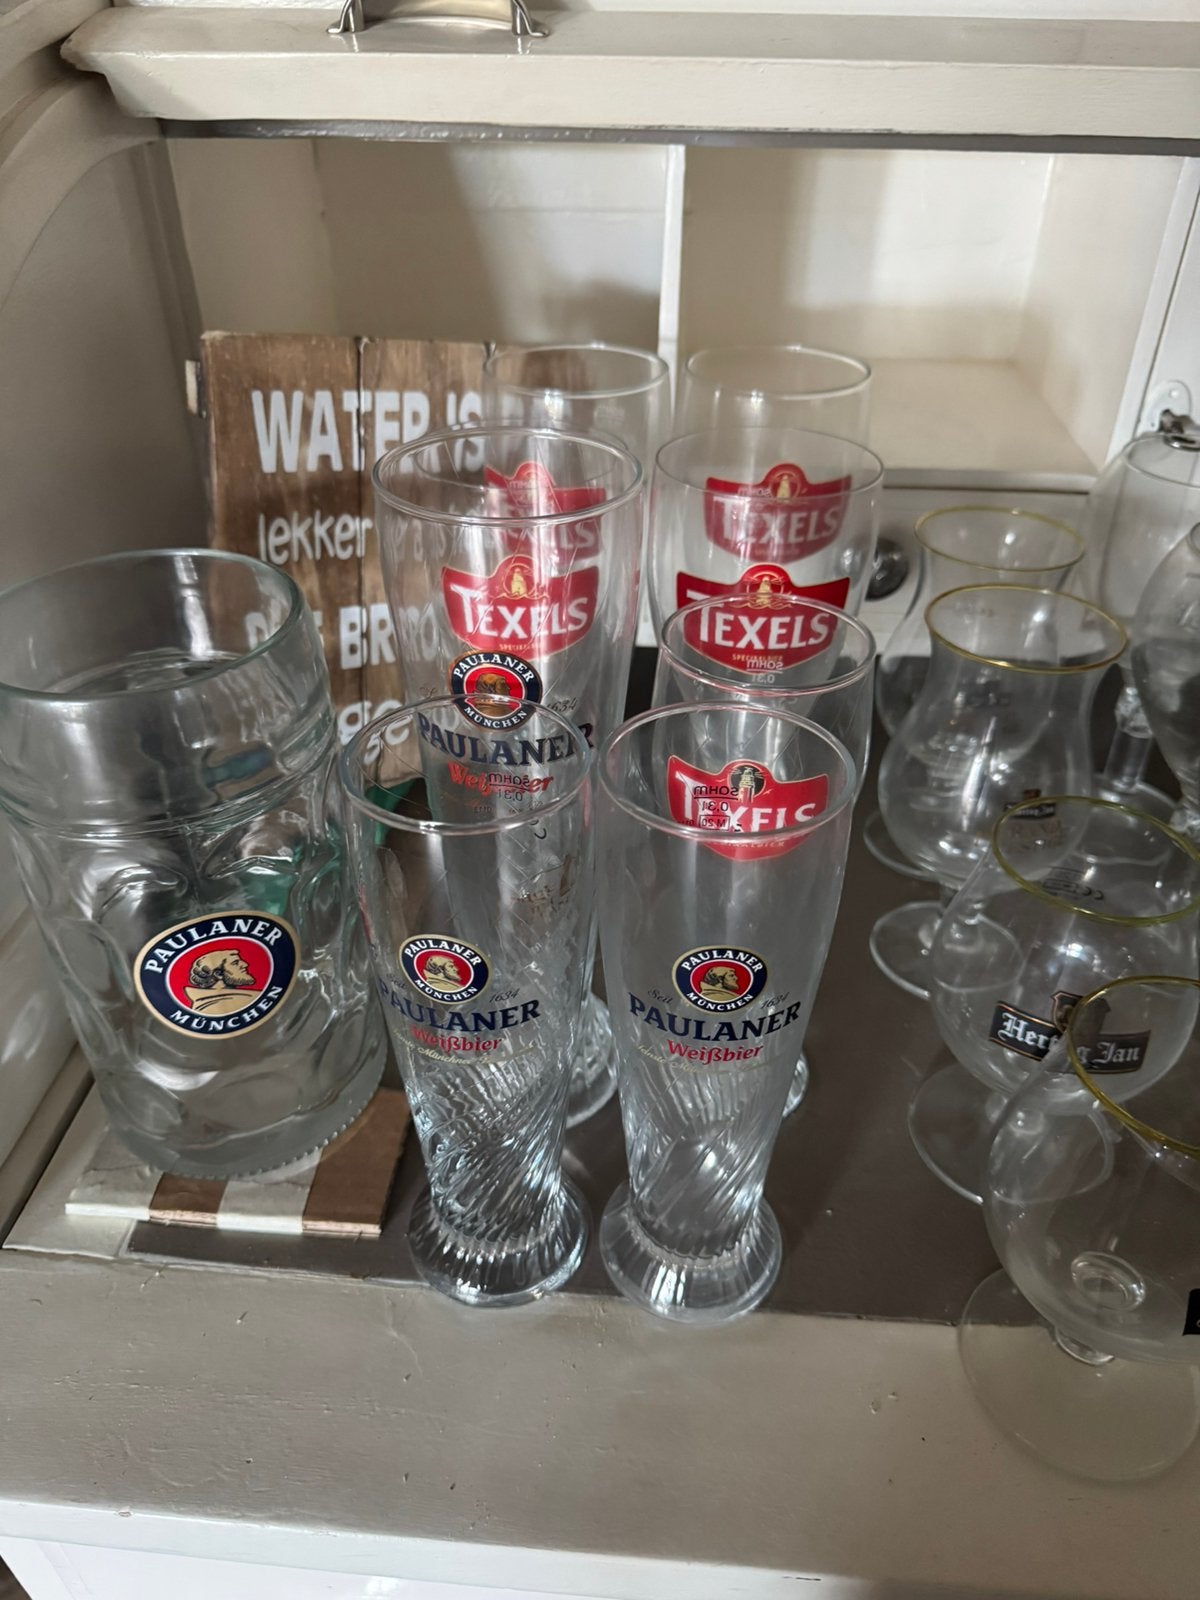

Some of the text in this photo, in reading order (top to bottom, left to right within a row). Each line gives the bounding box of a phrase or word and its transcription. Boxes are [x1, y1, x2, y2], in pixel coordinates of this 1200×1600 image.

[251, 389, 441, 474] WATER
[446, 391, 485, 472] IS
[257, 510, 374, 566] lekker
[712, 496, 841, 545] TEXELS
[450, 583, 589, 640] TEXELS
[686, 589, 831, 650] TEXELS
[452, 653, 536, 683] PAULANER
[416, 711, 595, 767] PAULANER
[144, 918, 283, 974] PAULANER
[404, 939, 483, 967] PAULANER
[680, 950, 764, 973] PAULANER
[170, 985, 283, 1032] MÜNCHEN
[379, 977, 542, 1033] PAULANER
[414, 978, 479, 1001] MÜNCHEN
[685, 992, 754, 1012] MÜNCHEN
[410, 1024, 502, 1054] Weißbier
[628, 991, 802, 1042] PAULANER
[666, 1038, 764, 1066] Weißbier
[1092, 1041, 1140, 1064] Jan
